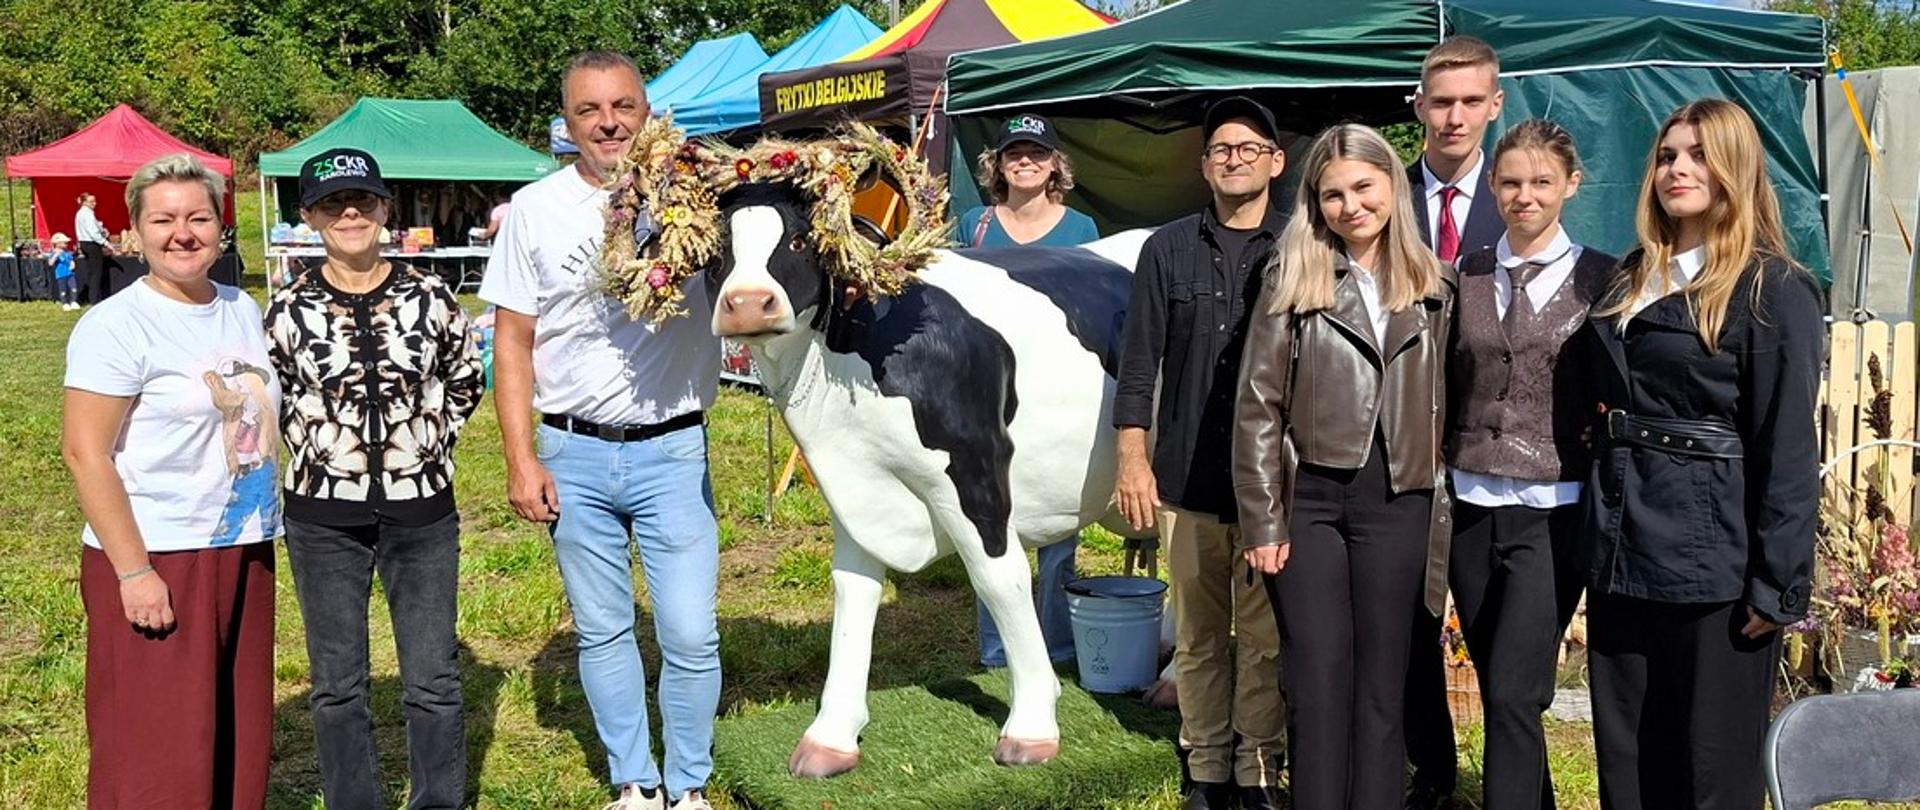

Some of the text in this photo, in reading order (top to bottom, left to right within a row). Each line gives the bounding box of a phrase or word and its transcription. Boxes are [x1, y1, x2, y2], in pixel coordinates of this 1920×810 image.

[776, 70, 886, 113] FRYTKI BELGIJSKIE
[313, 154, 369, 177] ZSCKR
